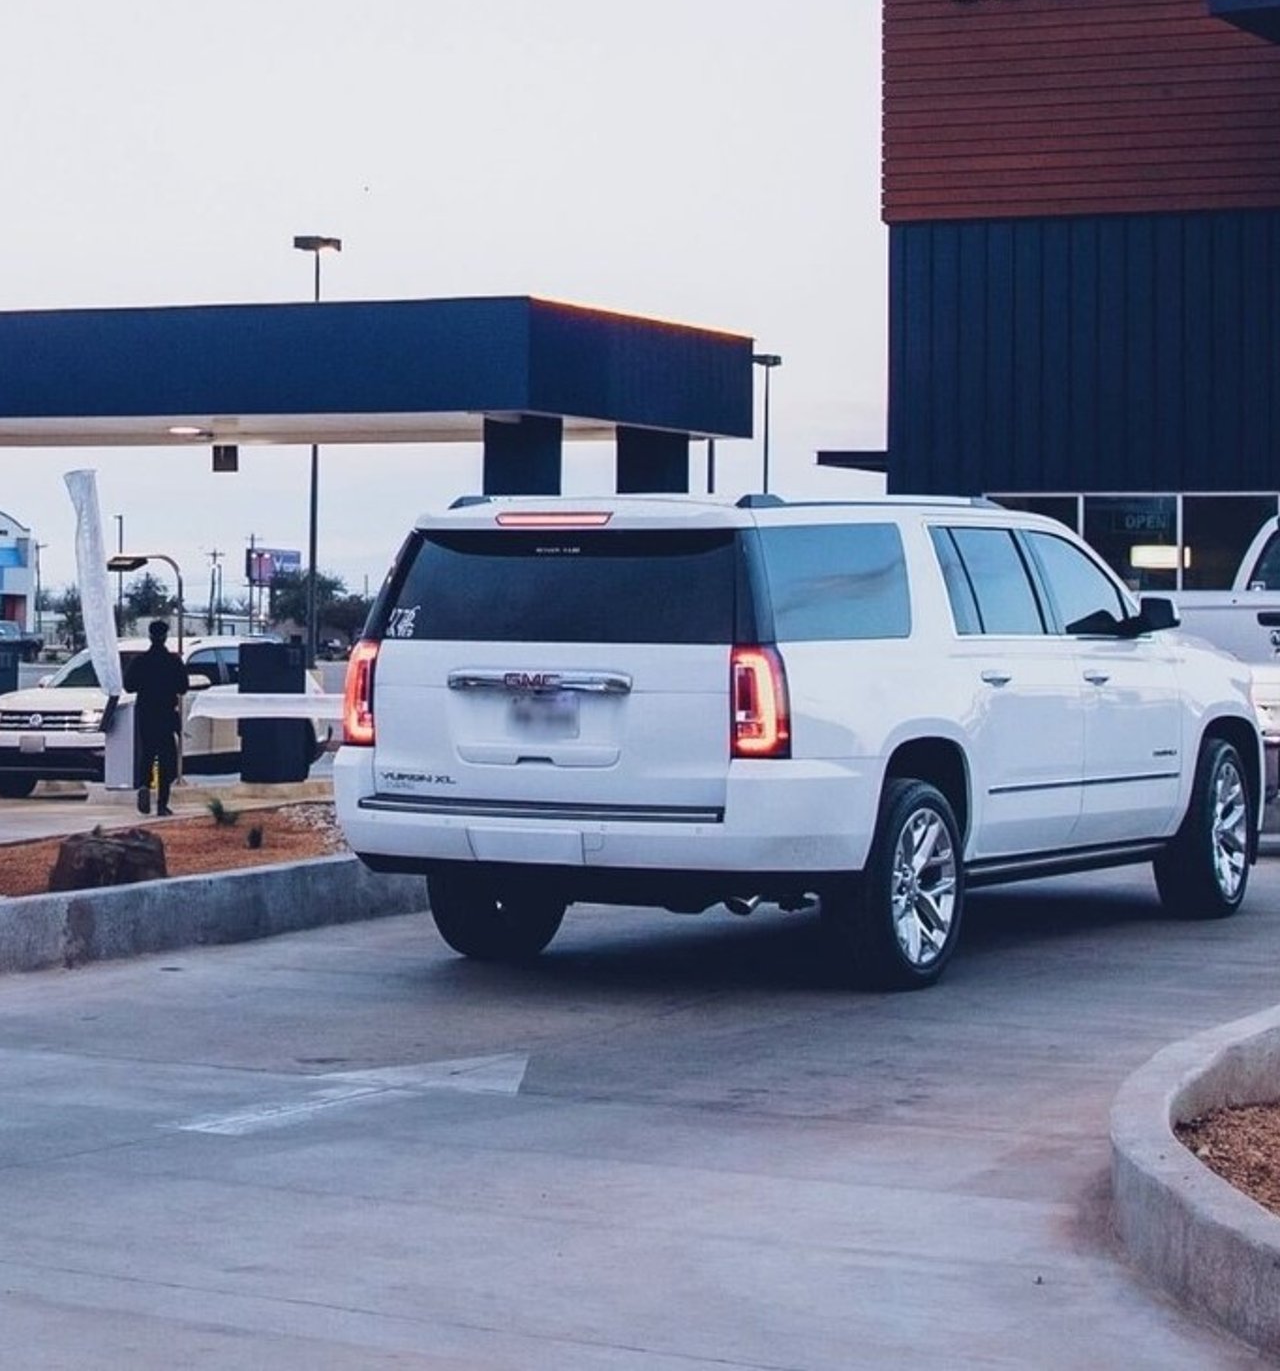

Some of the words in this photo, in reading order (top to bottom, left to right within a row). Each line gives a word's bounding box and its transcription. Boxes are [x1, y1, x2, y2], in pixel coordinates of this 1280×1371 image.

[1125, 514, 1167, 529] OPEN
[504, 672, 560, 688] GMC
[435, 775, 456, 784] XL
